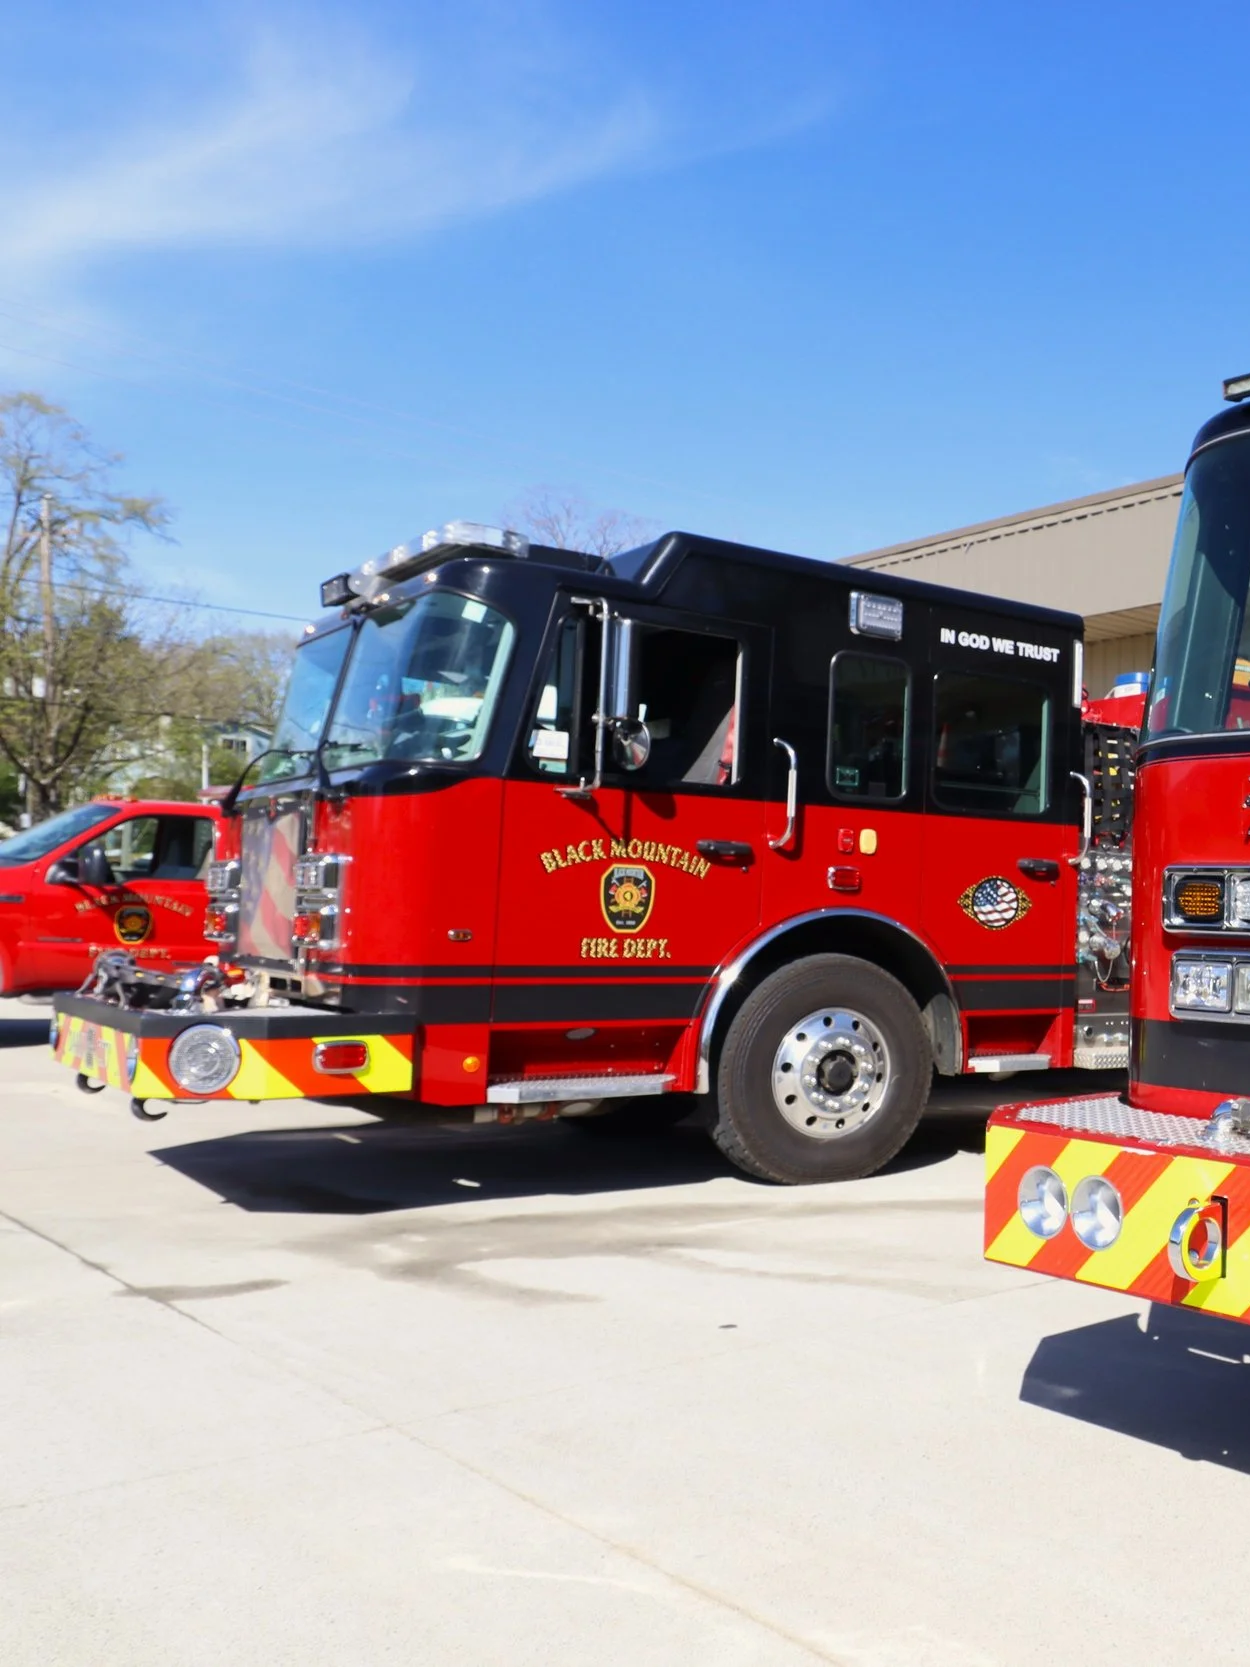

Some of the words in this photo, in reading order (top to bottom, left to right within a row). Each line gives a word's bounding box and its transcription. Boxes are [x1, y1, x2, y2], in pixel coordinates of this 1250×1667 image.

[940, 627, 956, 645] IN
[957, 631, 990, 651] GOD
[991, 636, 1015, 655] WE
[1016, 640, 1060, 663] TRUST
[539, 838, 607, 874] BLACK
[609, 837, 711, 880] MOUNTAIN
[580, 937, 620, 958] FIRE
[622, 937, 672, 958] DEPT.
